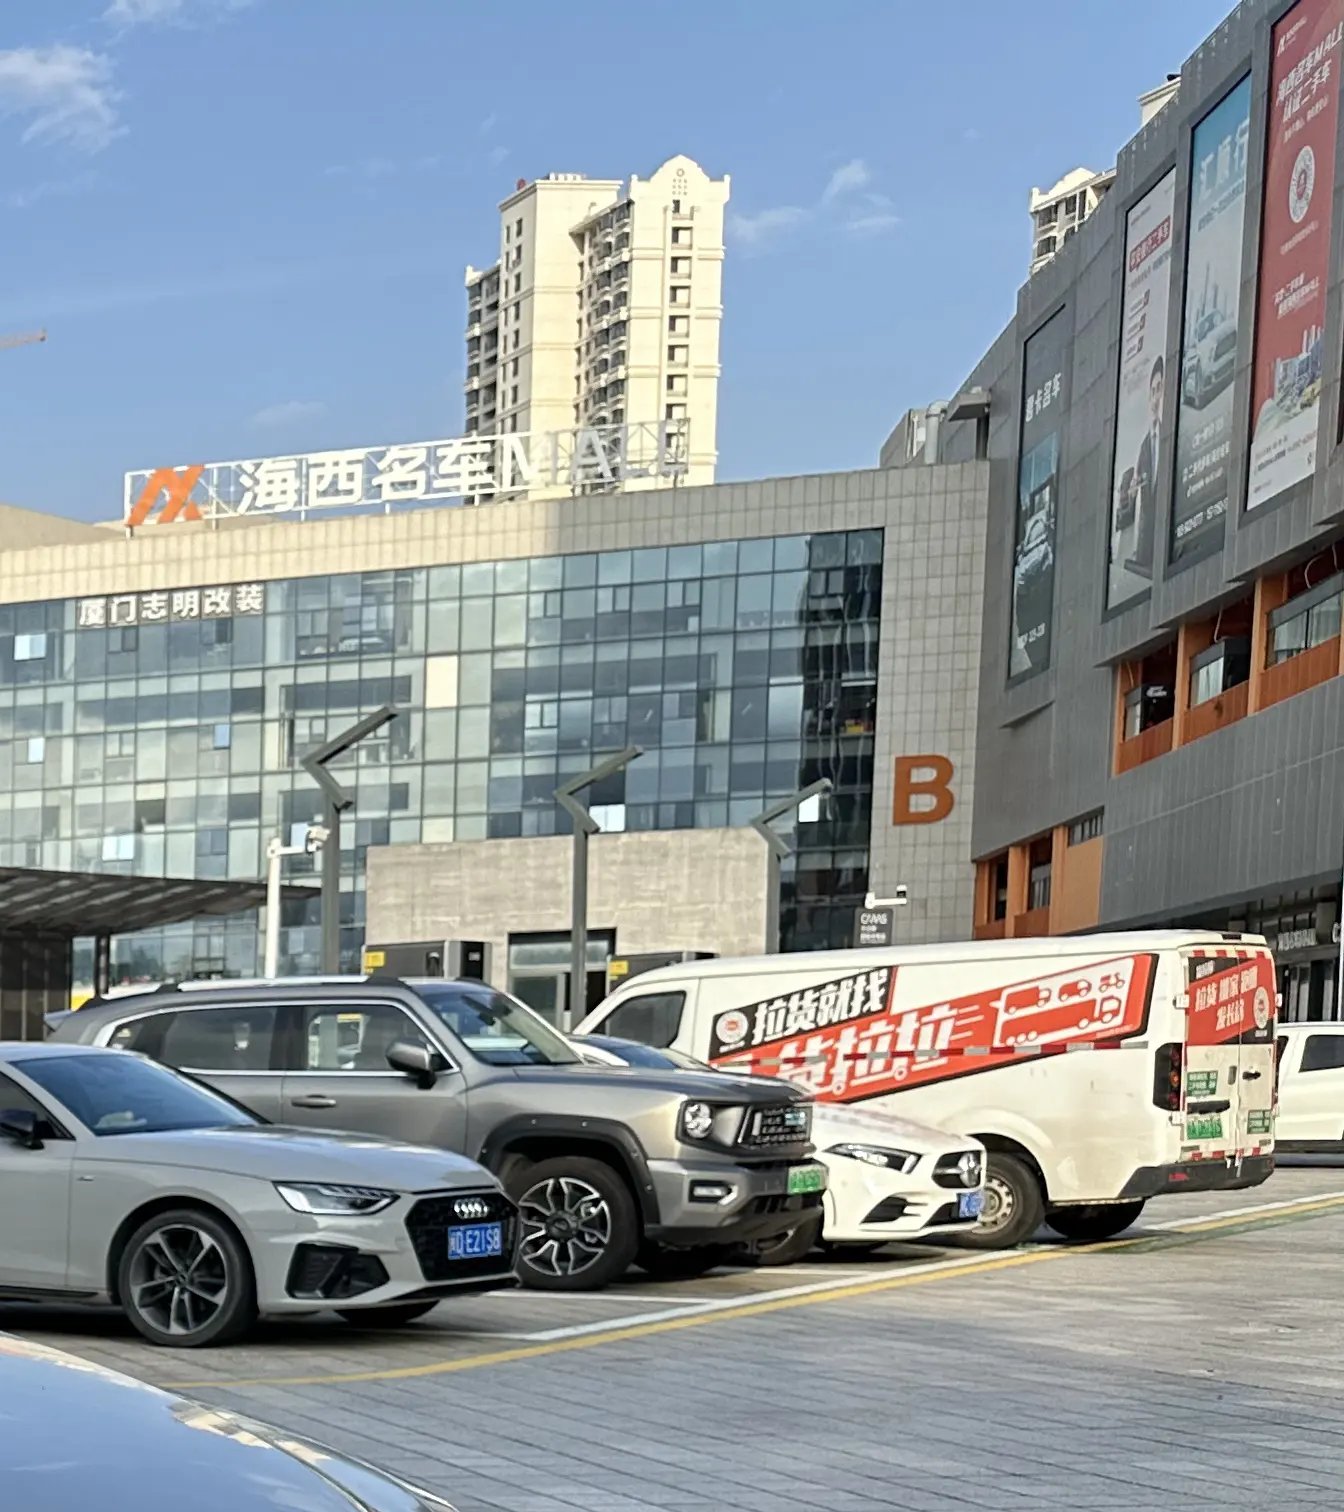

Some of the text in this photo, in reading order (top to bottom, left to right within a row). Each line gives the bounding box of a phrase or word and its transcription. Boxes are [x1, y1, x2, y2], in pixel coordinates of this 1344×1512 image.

[79, 584, 263, 629] 厦门志明改装
[893, 754, 955, 827] B
[752, 967, 889, 1046] 拉货就找
